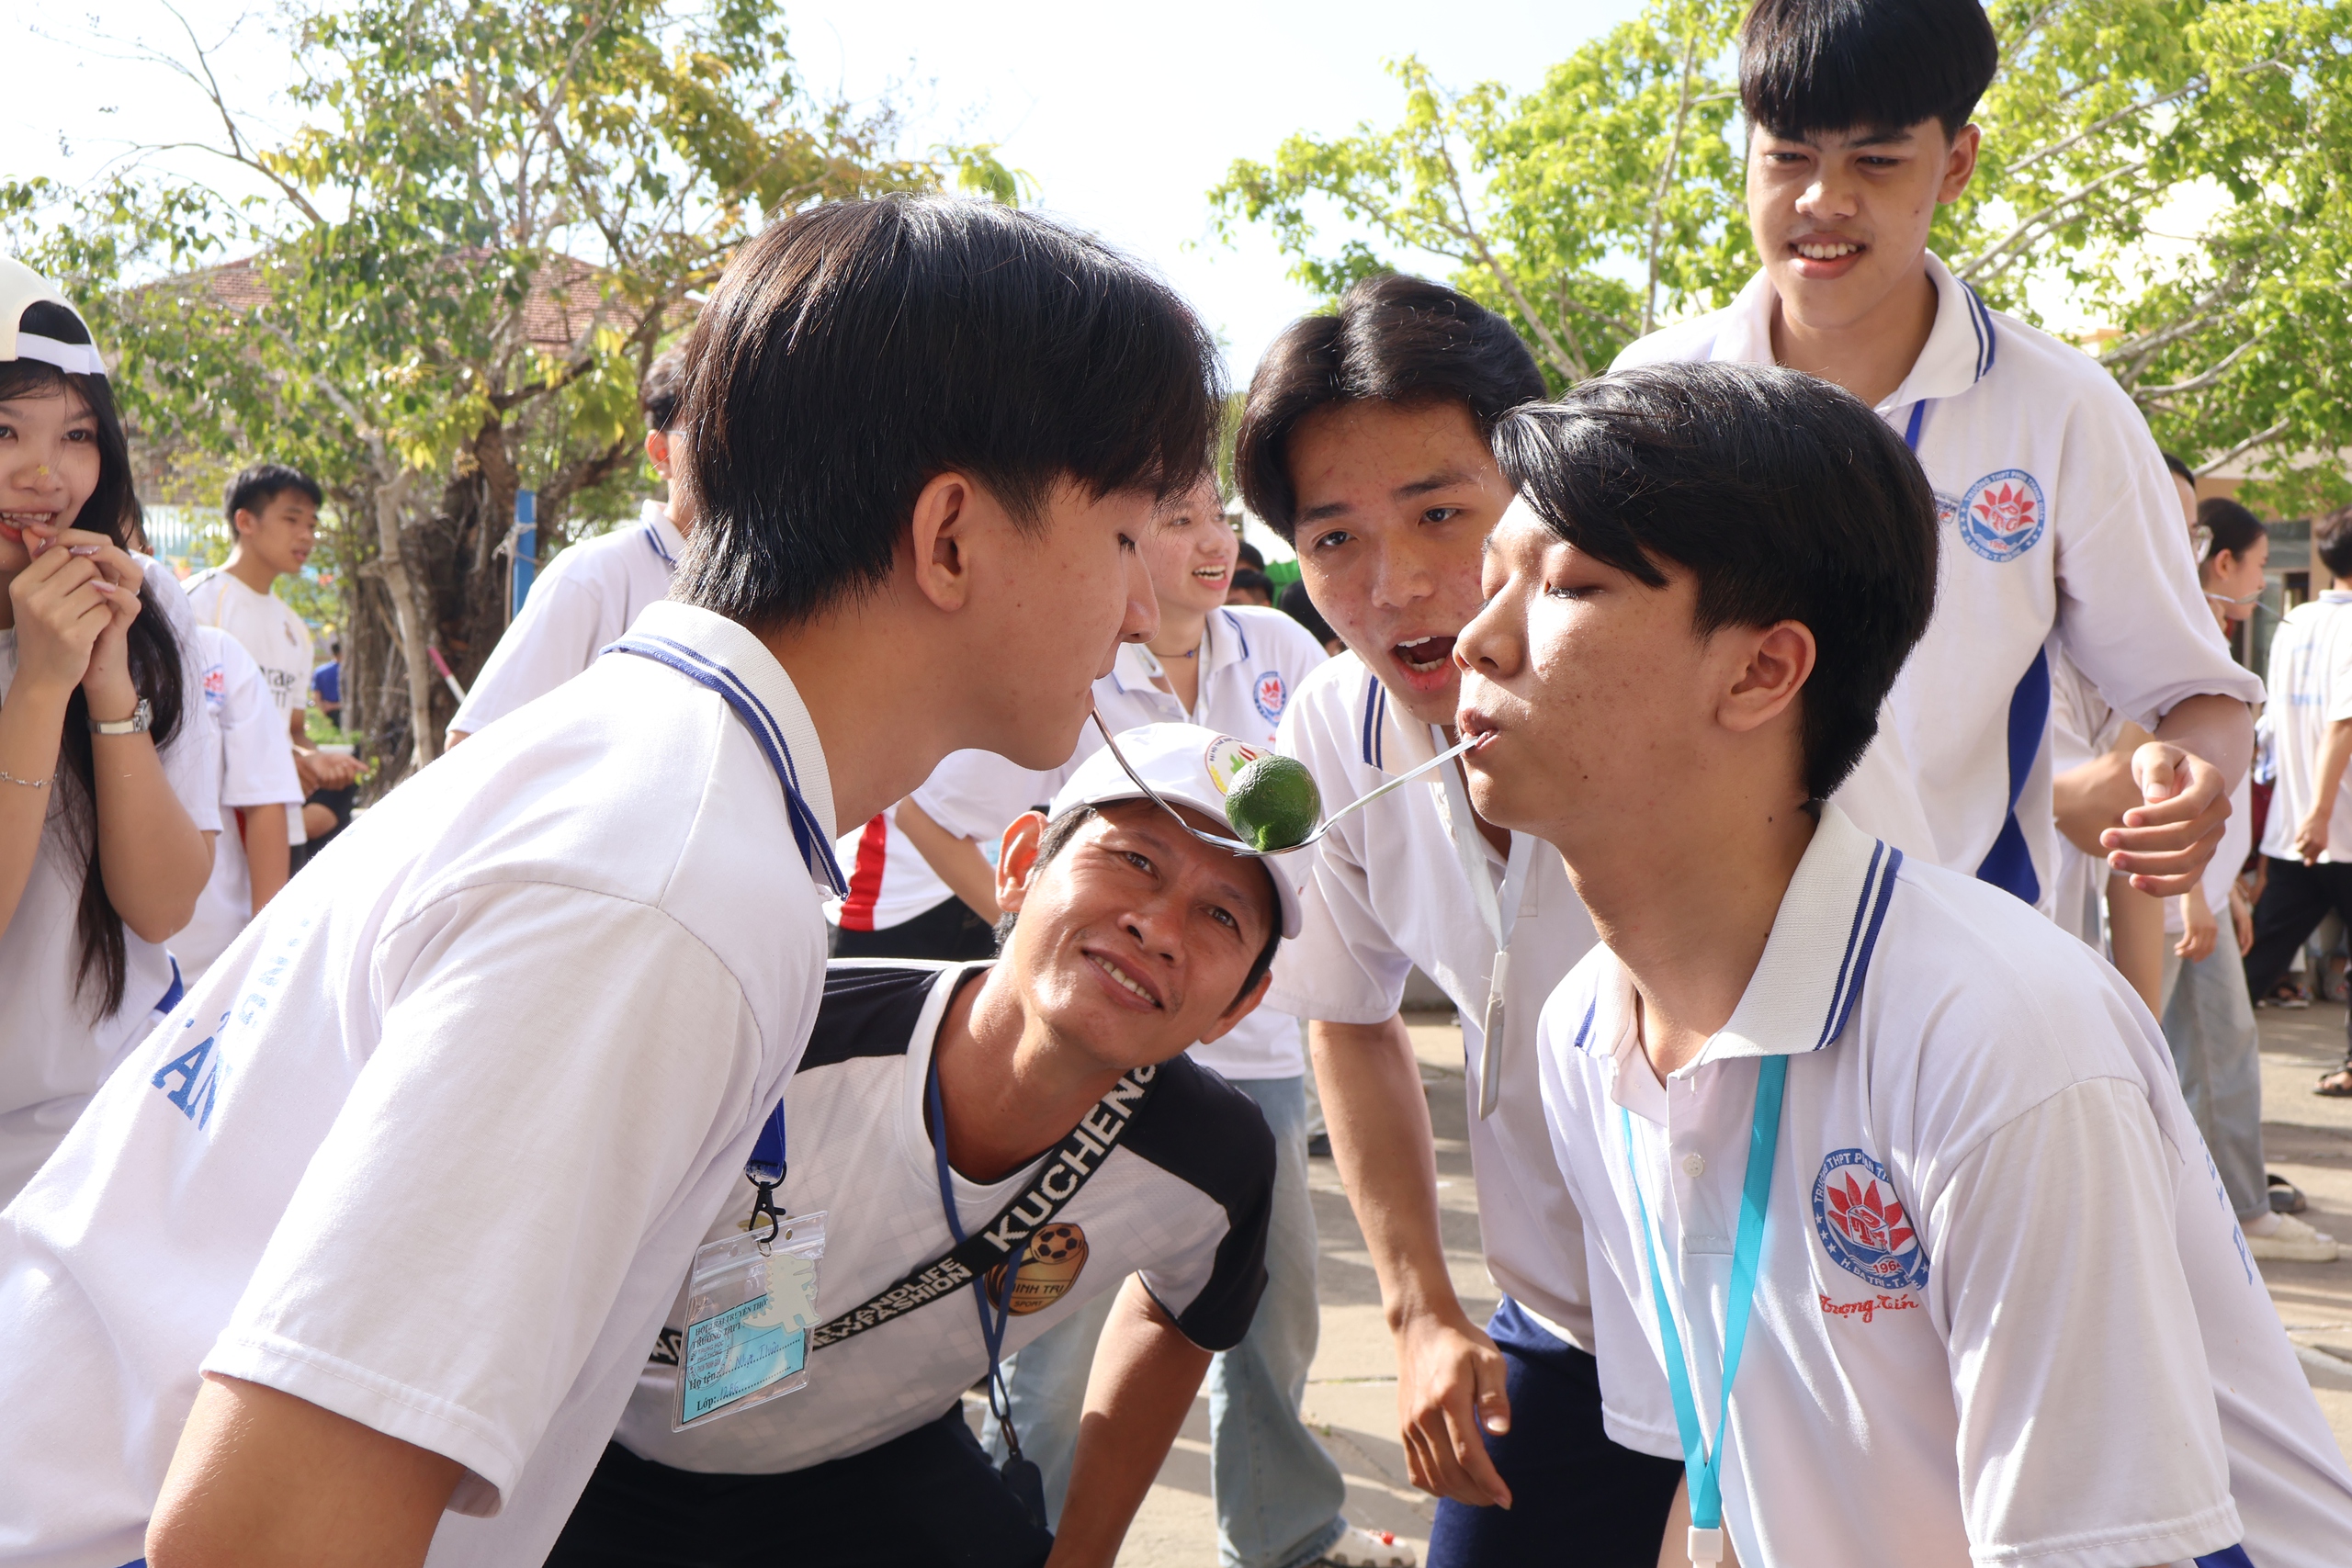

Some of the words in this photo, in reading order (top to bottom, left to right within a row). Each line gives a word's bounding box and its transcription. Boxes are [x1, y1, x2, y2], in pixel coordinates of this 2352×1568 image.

[1826, 1152, 1851, 1168] THPT
[1853, 1267, 1867, 1280] BA
[1868, 1276, 1885, 1287] TRI
[1014, 1300, 1044, 1308] SPORT
